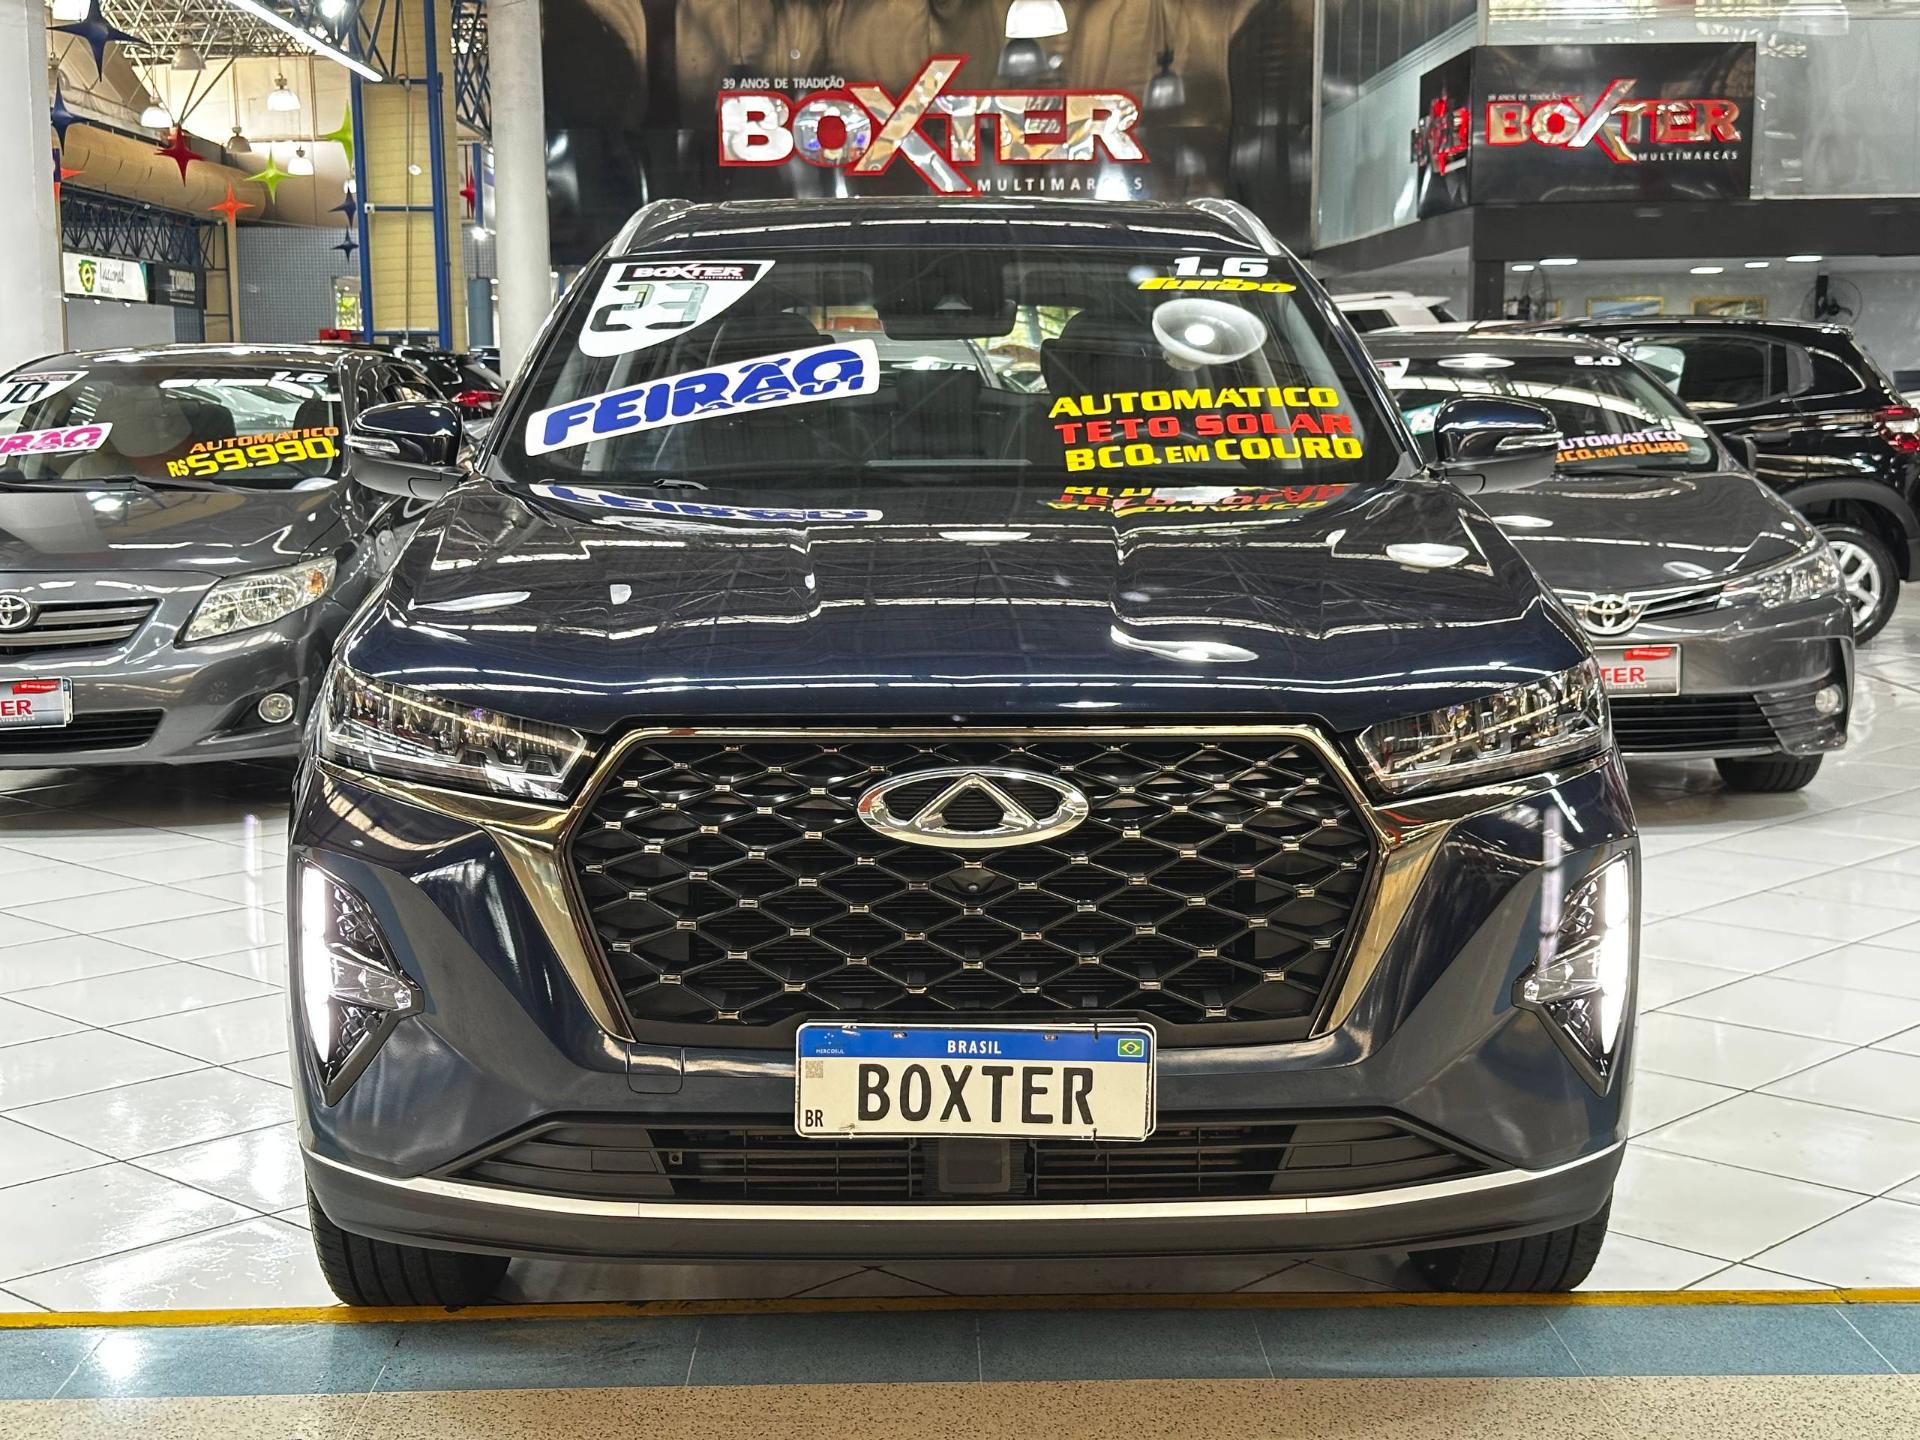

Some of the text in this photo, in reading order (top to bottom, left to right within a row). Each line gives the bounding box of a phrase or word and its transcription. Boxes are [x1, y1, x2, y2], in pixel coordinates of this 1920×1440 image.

[723, 75, 845, 90] 39 ANOS DE TRADIÇÃO
[718, 54, 1150, 197] BOXTER
[1485, 79, 1742, 163] BOXTER
[1638, 150, 1739, 161] MULTIMARCAS
[977, 178, 1144, 192] MULTIMARS
[632, 264, 744, 279] BOXTER
[1175, 253, 1269, 278] 1.6
[1573, 355, 1622, 367] 2.0
[543, 349, 864, 446] FEIRÃO
[1054, 412, 1353, 445] TETO SOLAR
[1065, 437, 1364, 472] BCO. EM COURO
[947, 1039, 1002, 1055] BRASIL
[857, 1063, 1094, 1125] BOXTER
[805, 1109, 824, 1128] BR
